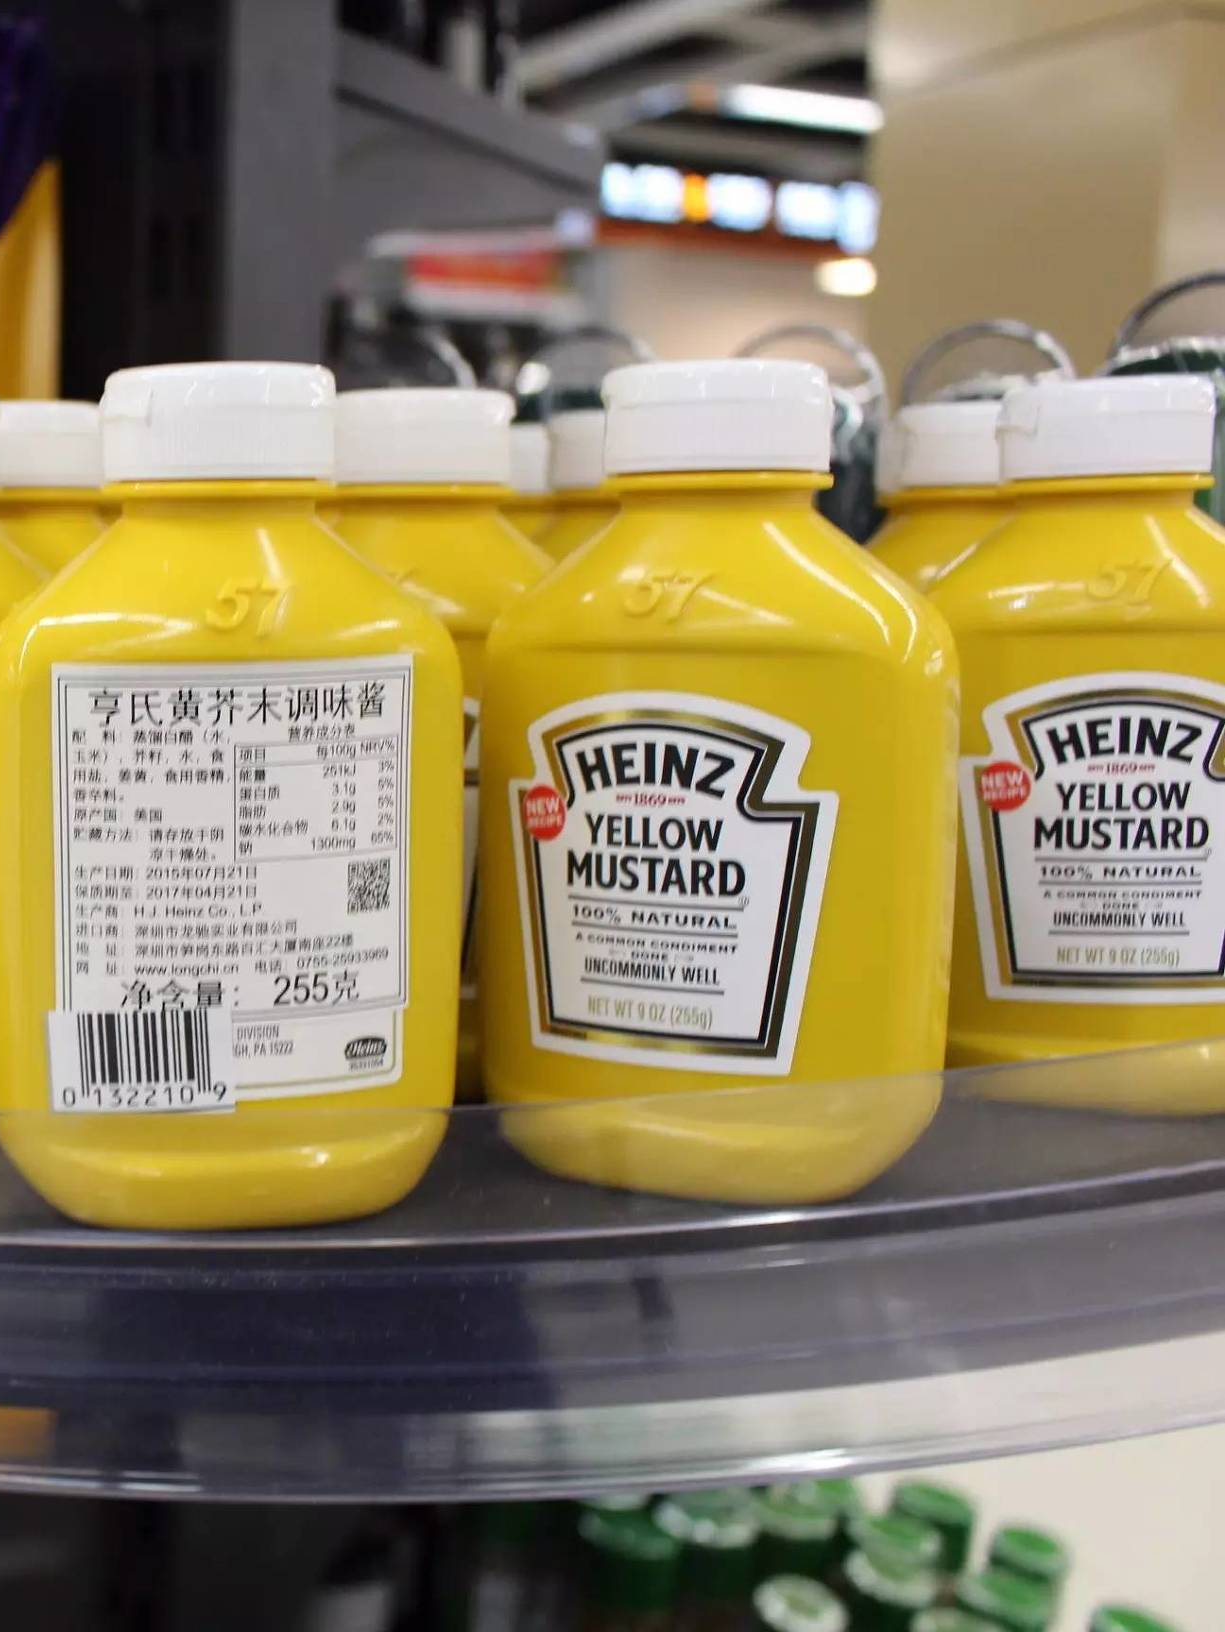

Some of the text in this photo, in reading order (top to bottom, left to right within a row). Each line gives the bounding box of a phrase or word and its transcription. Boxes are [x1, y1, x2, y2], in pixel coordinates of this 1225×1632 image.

[204, 577, 291, 640] 57
[622, 568, 716, 625] 57
[88, 680, 385, 728] 亨氏黄芥末调味酱
[1046, 716, 1203, 766] HEINZ
[575, 741, 736, 801] HEINZ
[981, 771, 1025, 788] NEW
[526, 796, 561, 816] NEW
[1055, 780, 1192, 813] YELLOW
[584, 811, 724, 853] YELLOW
[1033, 815, 1210, 851] MUSTARD
[566, 848, 746, 898] MUSTARD
[1040, 864, 1202, 882] 100% NATURAL
[573, 903, 737, 930] 100% NATURAL
[1053, 911, 1187, 928] UNCOMMONLY WELL
[587, 933, 646, 949] COMMON
[650, 940, 738, 955] CONDIMENT
[1056, 945, 1081, 964] NET
[1085, 945, 1105, 964] WT
[584, 955, 721, 986] UNCOMMONLY WELL
[273, 969, 360, 1007] 255克
[587, 995, 611, 1016] NET
[614, 999, 635, 1020] WT
[648, 1003, 666, 1024] OZ
[63, 1080, 227, 1108] 0 132210 9
